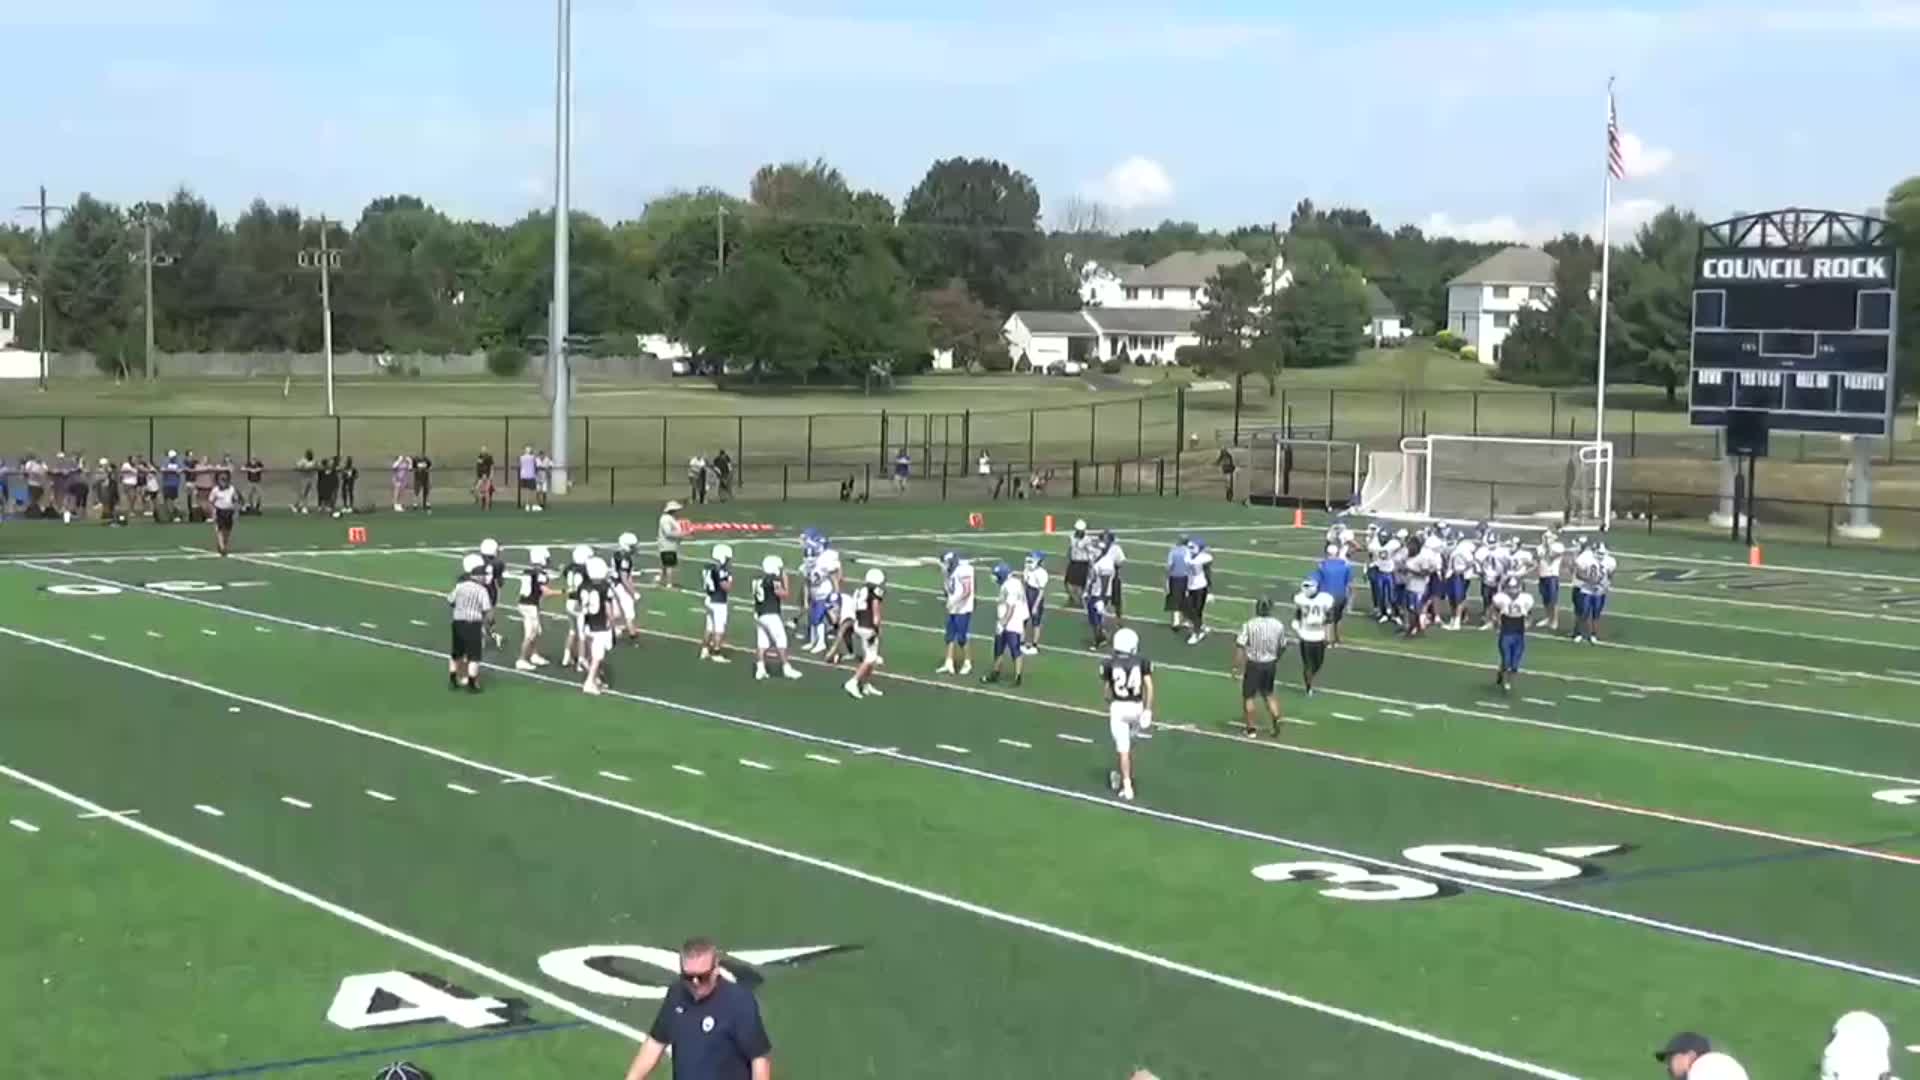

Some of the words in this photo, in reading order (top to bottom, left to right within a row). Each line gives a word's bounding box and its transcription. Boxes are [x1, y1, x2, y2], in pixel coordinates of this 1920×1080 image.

[1703, 258, 1808, 279] COUNCIL
[1813, 256, 1887, 279] ROCK
[1112, 666, 1143, 698] 24
[1252, 844, 1583, 900] 30
[326, 945, 738, 1030] 40
